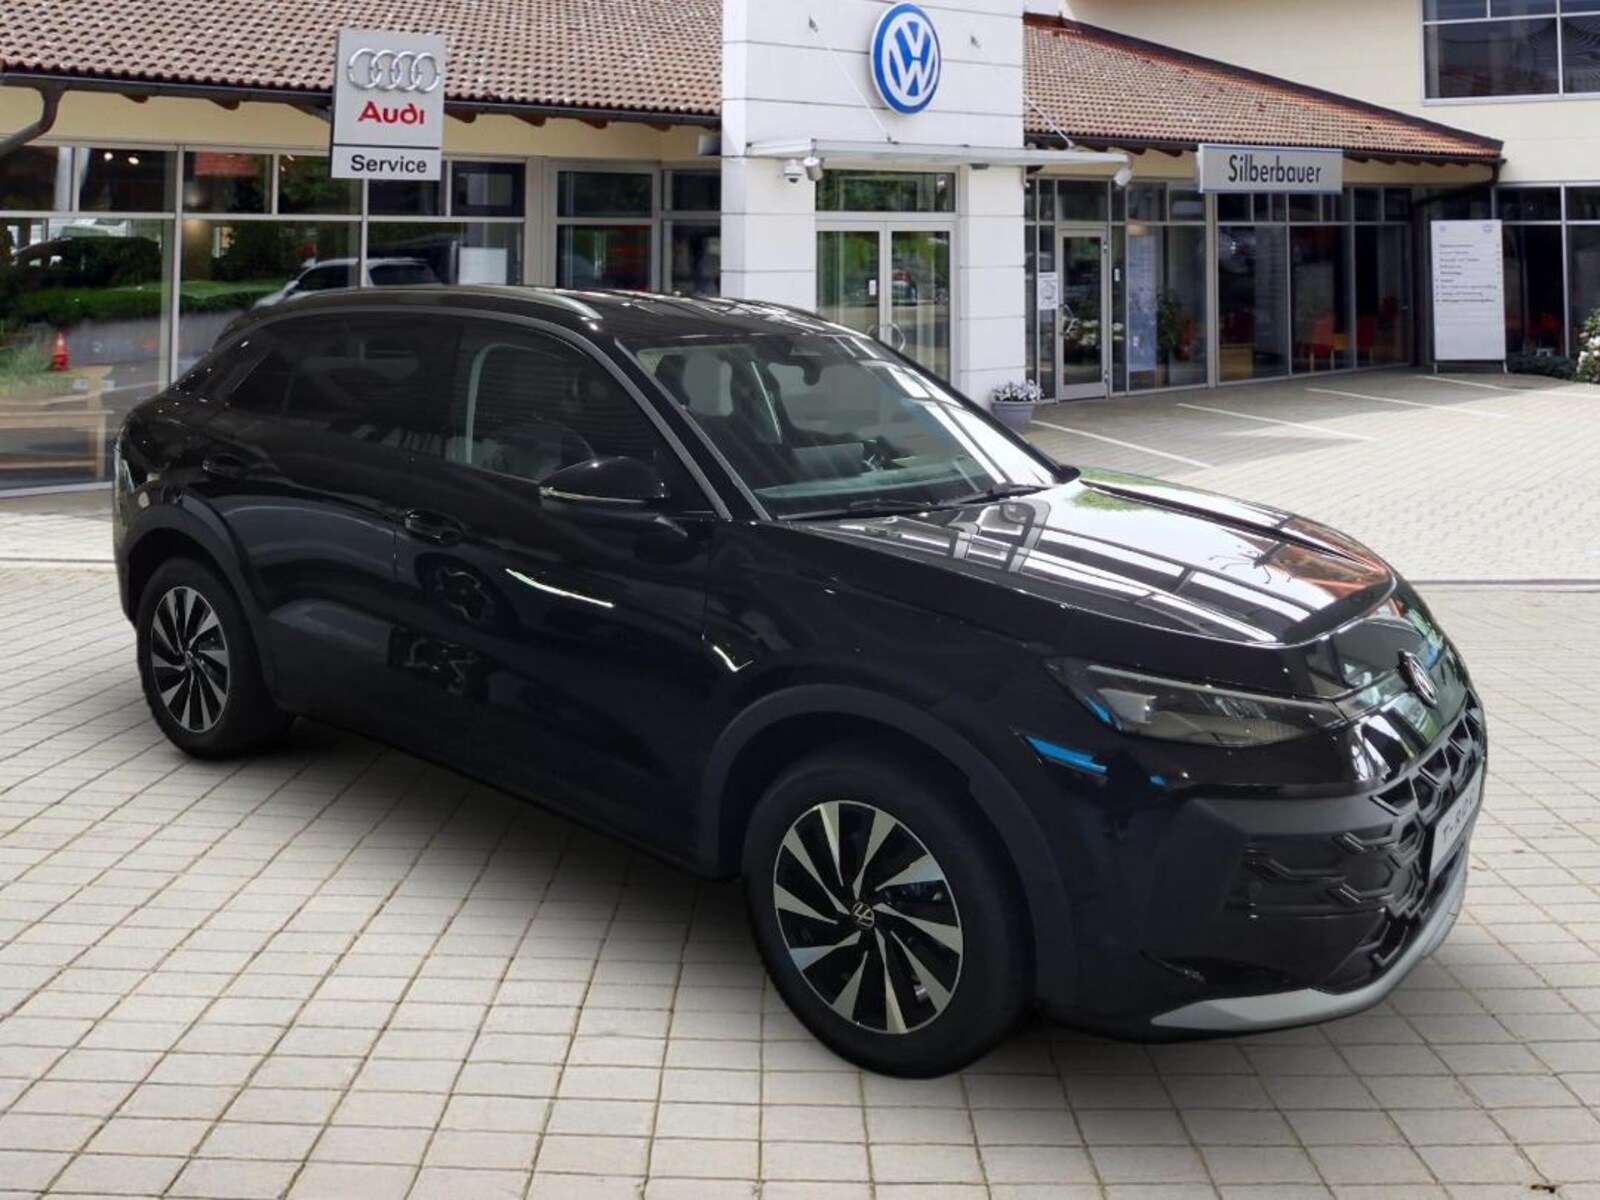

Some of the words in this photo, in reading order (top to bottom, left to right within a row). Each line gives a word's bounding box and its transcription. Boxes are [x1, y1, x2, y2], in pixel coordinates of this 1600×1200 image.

[880, 10, 937, 108] VW
[358, 100, 425, 125] Audi
[351, 154, 427, 174] Service
[1228, 154, 1321, 183] Silberbauer
